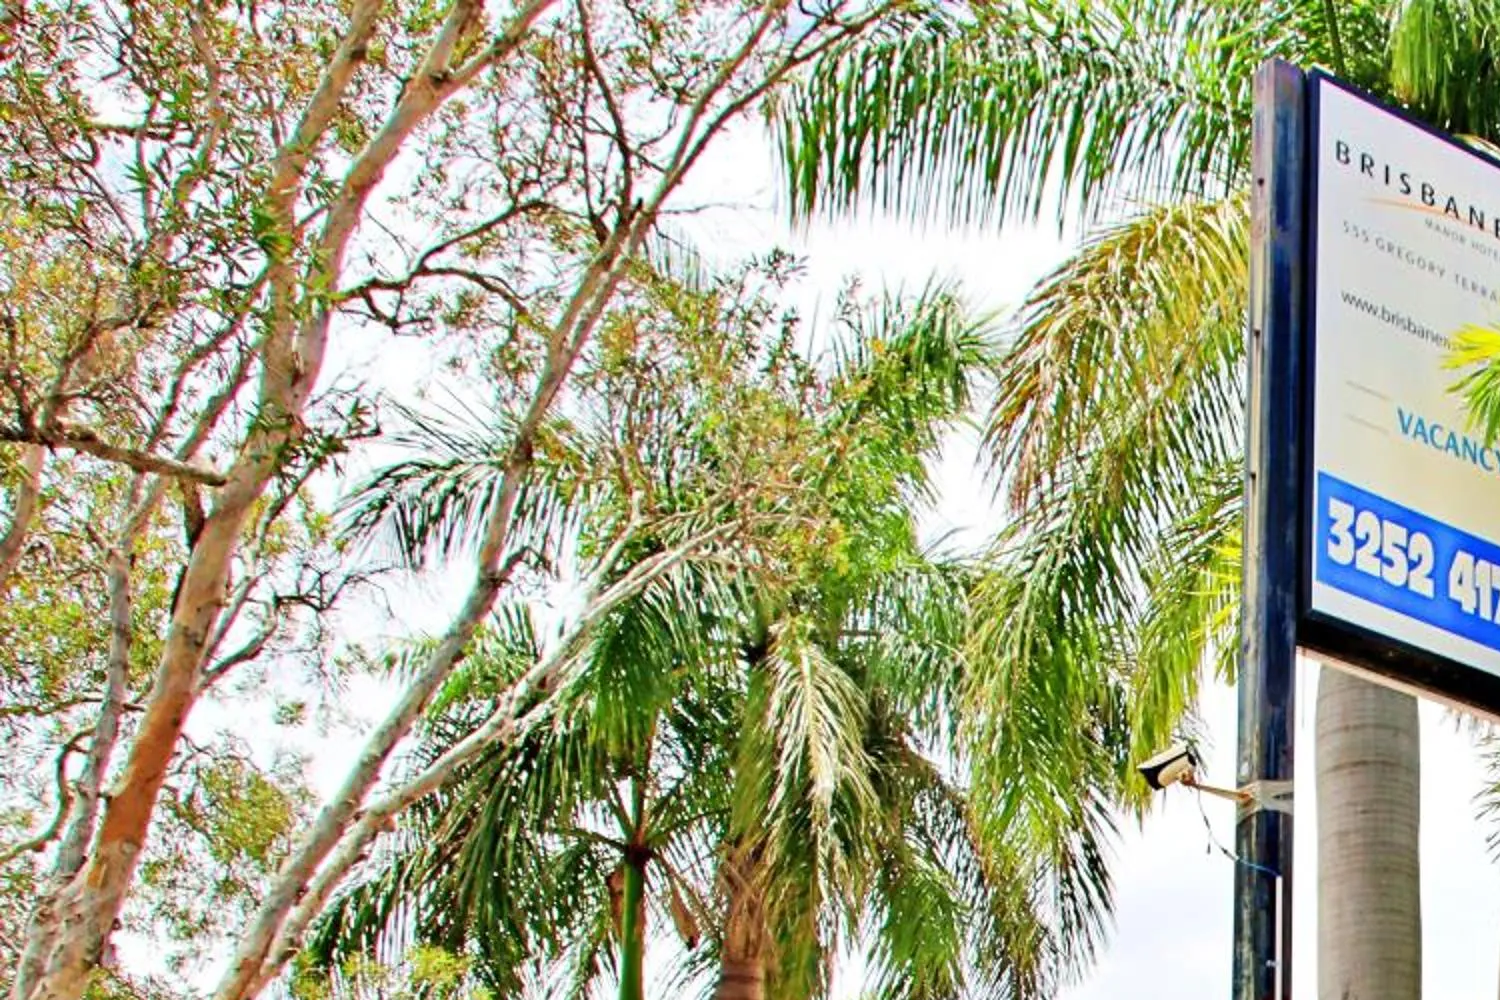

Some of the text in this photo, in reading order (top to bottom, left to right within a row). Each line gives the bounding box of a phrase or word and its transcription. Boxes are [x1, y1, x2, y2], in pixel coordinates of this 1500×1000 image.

[1343, 220, 1369, 243] 555
[1376, 238, 1445, 277] GREGORY
[1327, 496, 1434, 599] 3252
